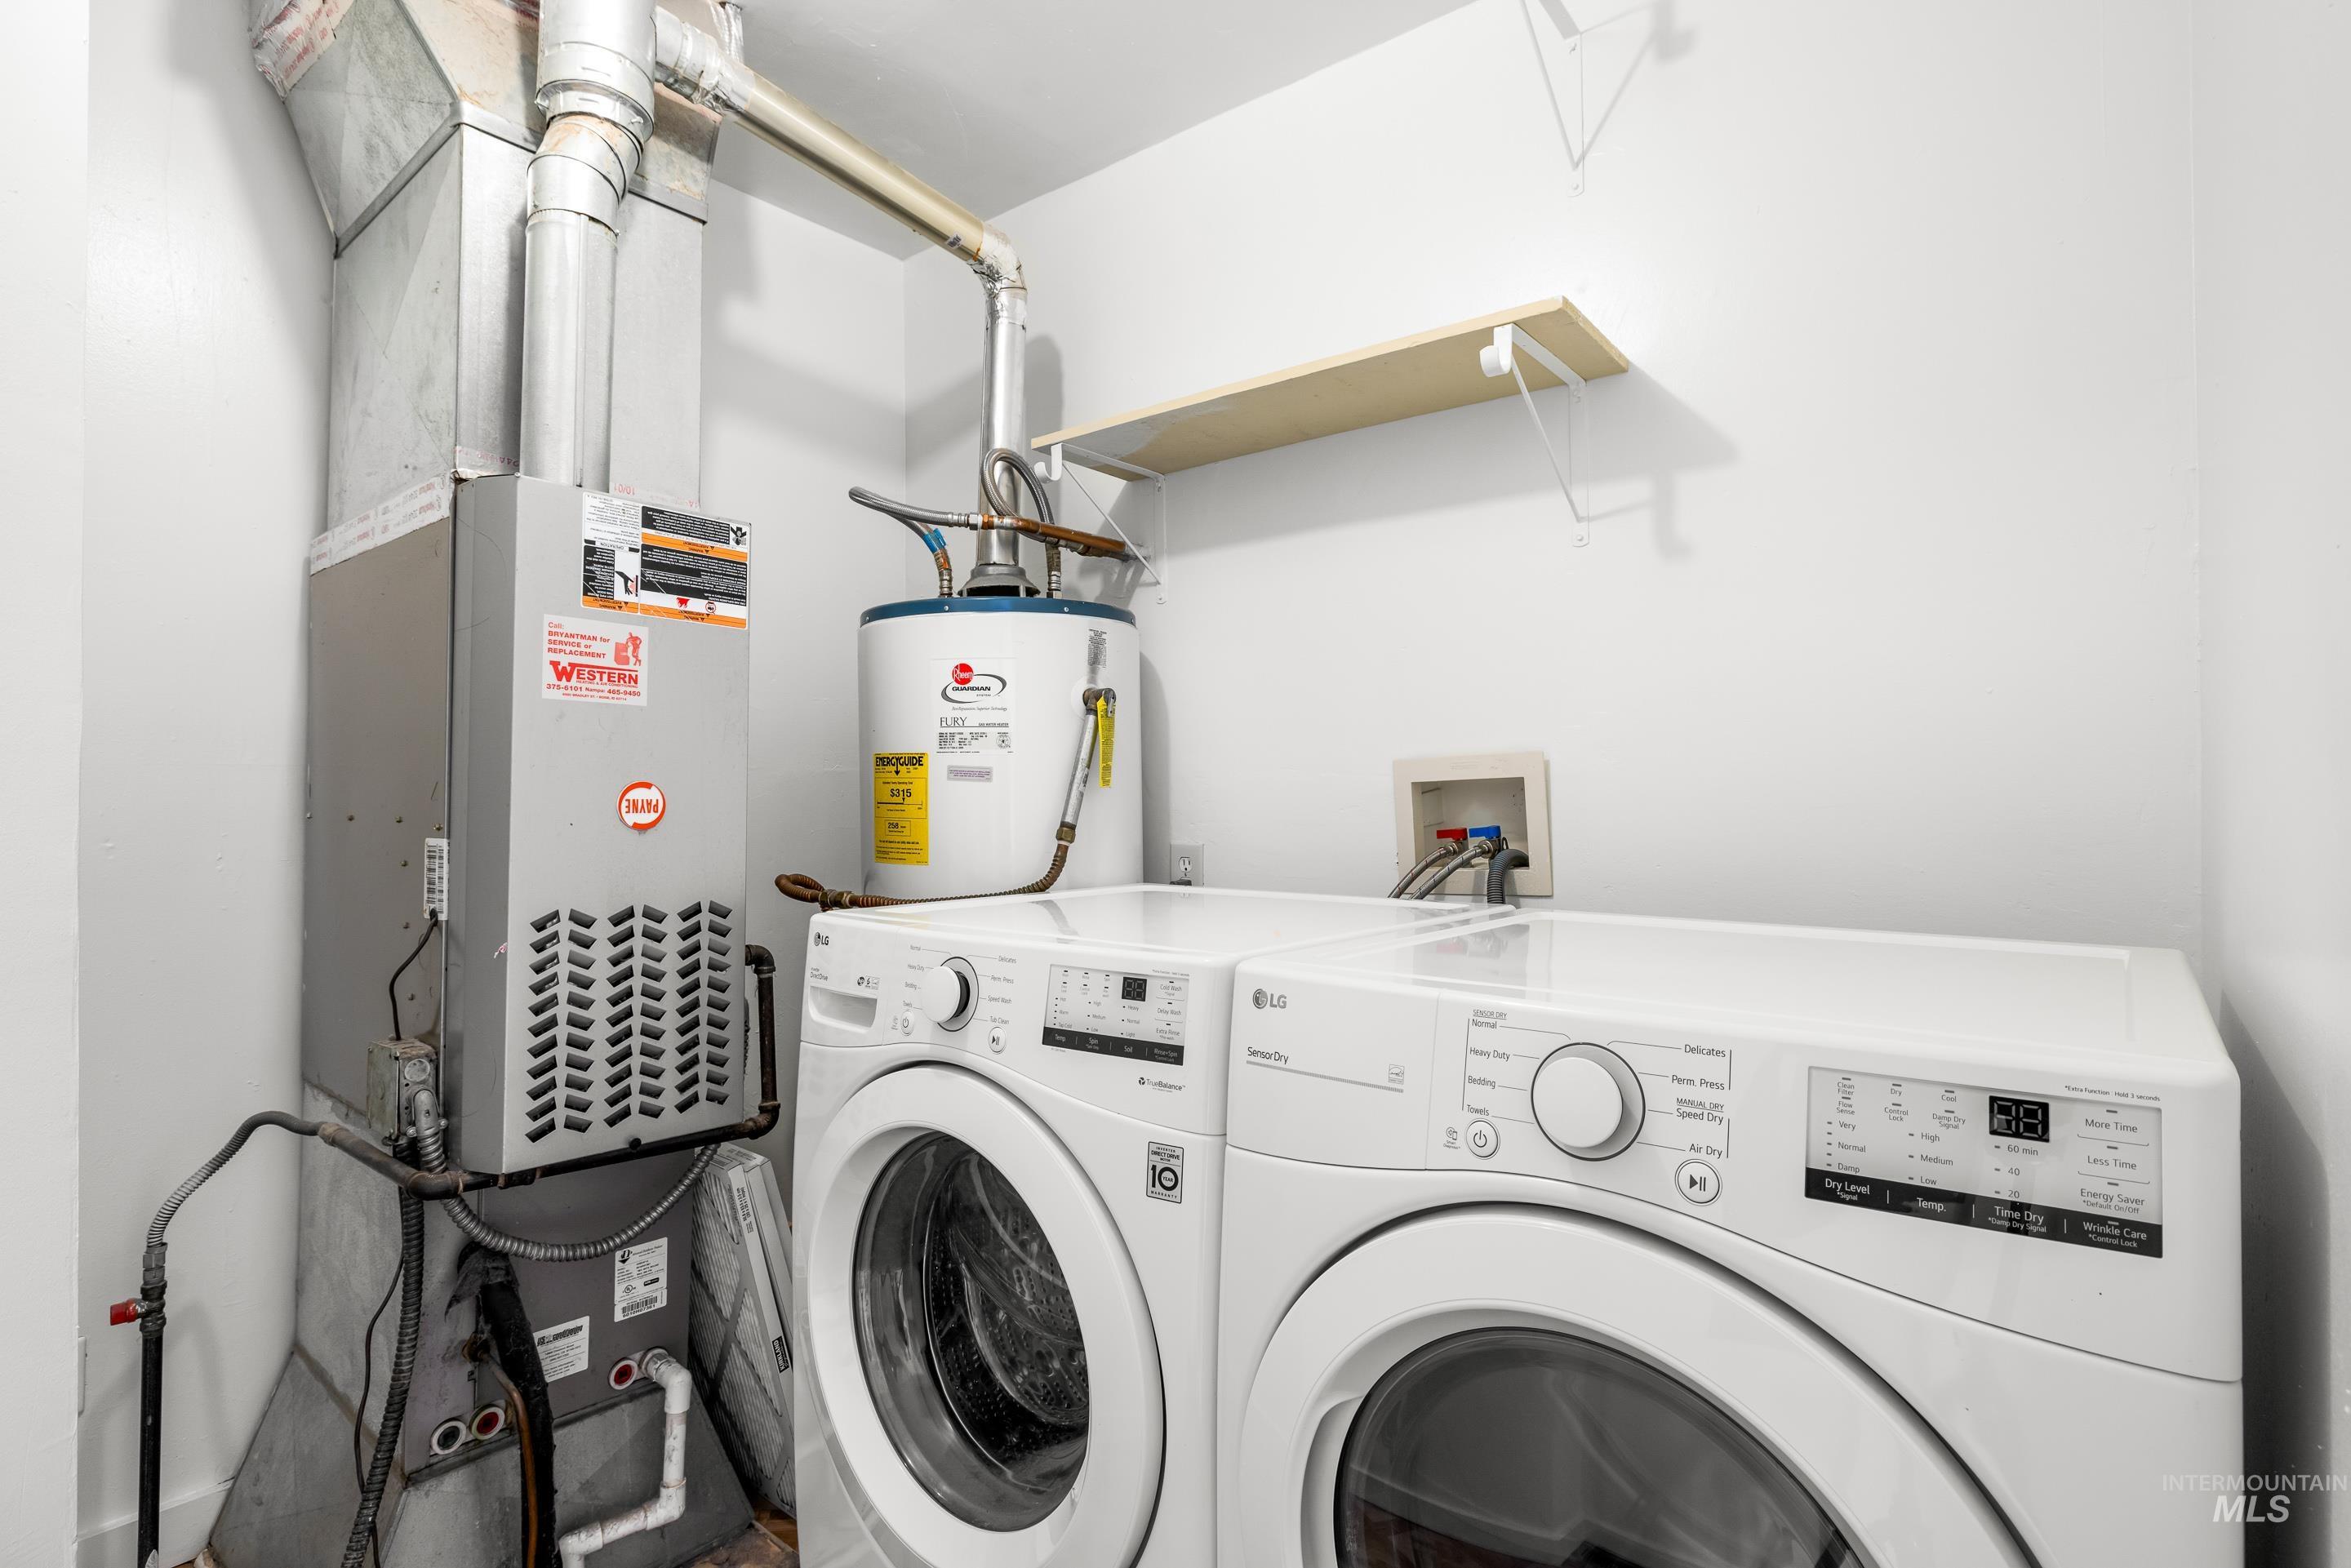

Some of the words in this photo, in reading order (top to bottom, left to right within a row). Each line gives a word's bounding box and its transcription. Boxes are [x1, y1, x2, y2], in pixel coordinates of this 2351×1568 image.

[549, 630, 598, 642] BRYANTMAN
[548, 639, 582, 648] SERVICE
[547, 647, 607, 659] REPLACEMENT
[549, 660, 638, 685] WESTERN
[953, 664, 973, 681] Rheem
[607, 689, 641, 697] 465-9450
[940, 717, 967, 726] FURY
[890, 788, 912, 797] $315
[998, 955, 1017, 964] Delicates
[1003, 976, 1014, 984] Press
[988, 995, 1000, 1004] Speed
[1158, 1007, 1169, 1015] Delay
[1473, 1009, 1495, 1019] SENSOR
[998, 1017, 1010, 1025] Clean
[1472, 1019, 1497, 1029] Normal
[1156, 1027, 1167, 1035] Extra
[1168, 1028, 1180, 1037] Rinse
[1089, 1037, 1099, 1045] Spin
[1124, 1045, 1133, 1053] Soil
[1469, 1046, 1491, 1059] Heavy
[1492, 1050, 1510, 1062] Duty
[1684, 1044, 1726, 1058] Delicates
[1468, 1076, 1495, 1089] Bedding
[1672, 1074, 1696, 1087] Perm.
[1700, 1078, 1725, 1090] Press
[1837, 1082, 1855, 1090] Clean
[1838, 1088, 1855, 1096] Filter
[1891, 1088, 1902, 1097] Dry
[2085, 1087, 2110, 1096] Function
[2114, 1090, 2129, 1099] Hold
[2135, 1094, 2161, 1102] seconds
[1676, 1097, 1707, 1108] MANUAL
[1709, 1102, 1724, 1111] DRY
[1838, 1100, 1853, 1108] Flow
[1466, 1104, 1490, 1117] Towels
[1837, 1107, 1855, 1115] Sense
[1884, 1107, 1909, 1116] Control
[1677, 1108, 1704, 1121] Speed
[1707, 1112, 1724, 1126] Dry
[1933, 1113, 1952, 1123] Damp
[1953, 1116, 1966, 1125] Dry
[1838, 1120, 1856, 1131] Very
[1939, 1122, 1959, 1130] Signal
[2085, 1118, 2110, 1130] More
[2114, 1122, 2138, 1133] Time
[1921, 1132, 1940, 1143] High
[1689, 1143, 1703, 1154] Air
[1706, 1146, 1722, 1159] Dry
[1838, 1141, 1866, 1153] Normal
[2007, 1144, 2020, 1153] 60
[2023, 1147, 2038, 1156] min
[1151, 1149, 1166, 1157] DIRECT
[1167, 1153, 1180, 1161] DRIVE
[1920, 1154, 1953, 1166] Medium
[1838, 1162, 1860, 1174] Damp
[2088, 1156, 2109, 1166] Less
[2113, 1159, 2137, 1170] Time
[2008, 1167, 2020, 1175] 40
[1151, 1164, 1179, 1192] 10
[1920, 1175, 1937, 1185] Low
[1825, 1179, 1842, 1192] Dry
[1845, 1182, 1870, 1195] Level
[1151, 1190, 1177, 1198] WARRANTY
[2008, 1190, 2020, 1198] 20
[2080, 1188, 2114, 1203] Energy
[2118, 1193, 2145, 1206] Saver
[1917, 1197, 1946, 1213] Temp.
[2114, 1205, 2140, 1215] On/Off
[1993, 1206, 2021, 1219] Time
[2024, 1210, 2044, 1225] Dry
[2011, 1221, 2024, 1229] Dry
[2026, 1223, 2047, 1233] Signal
[2083, 1221, 2121, 1237] Wrinkle
[2123, 1228, 2147, 1241] Care
[2121, 1239, 2138, 1247] Lock
[774, 1339, 785, 1371] KIRKLAND
